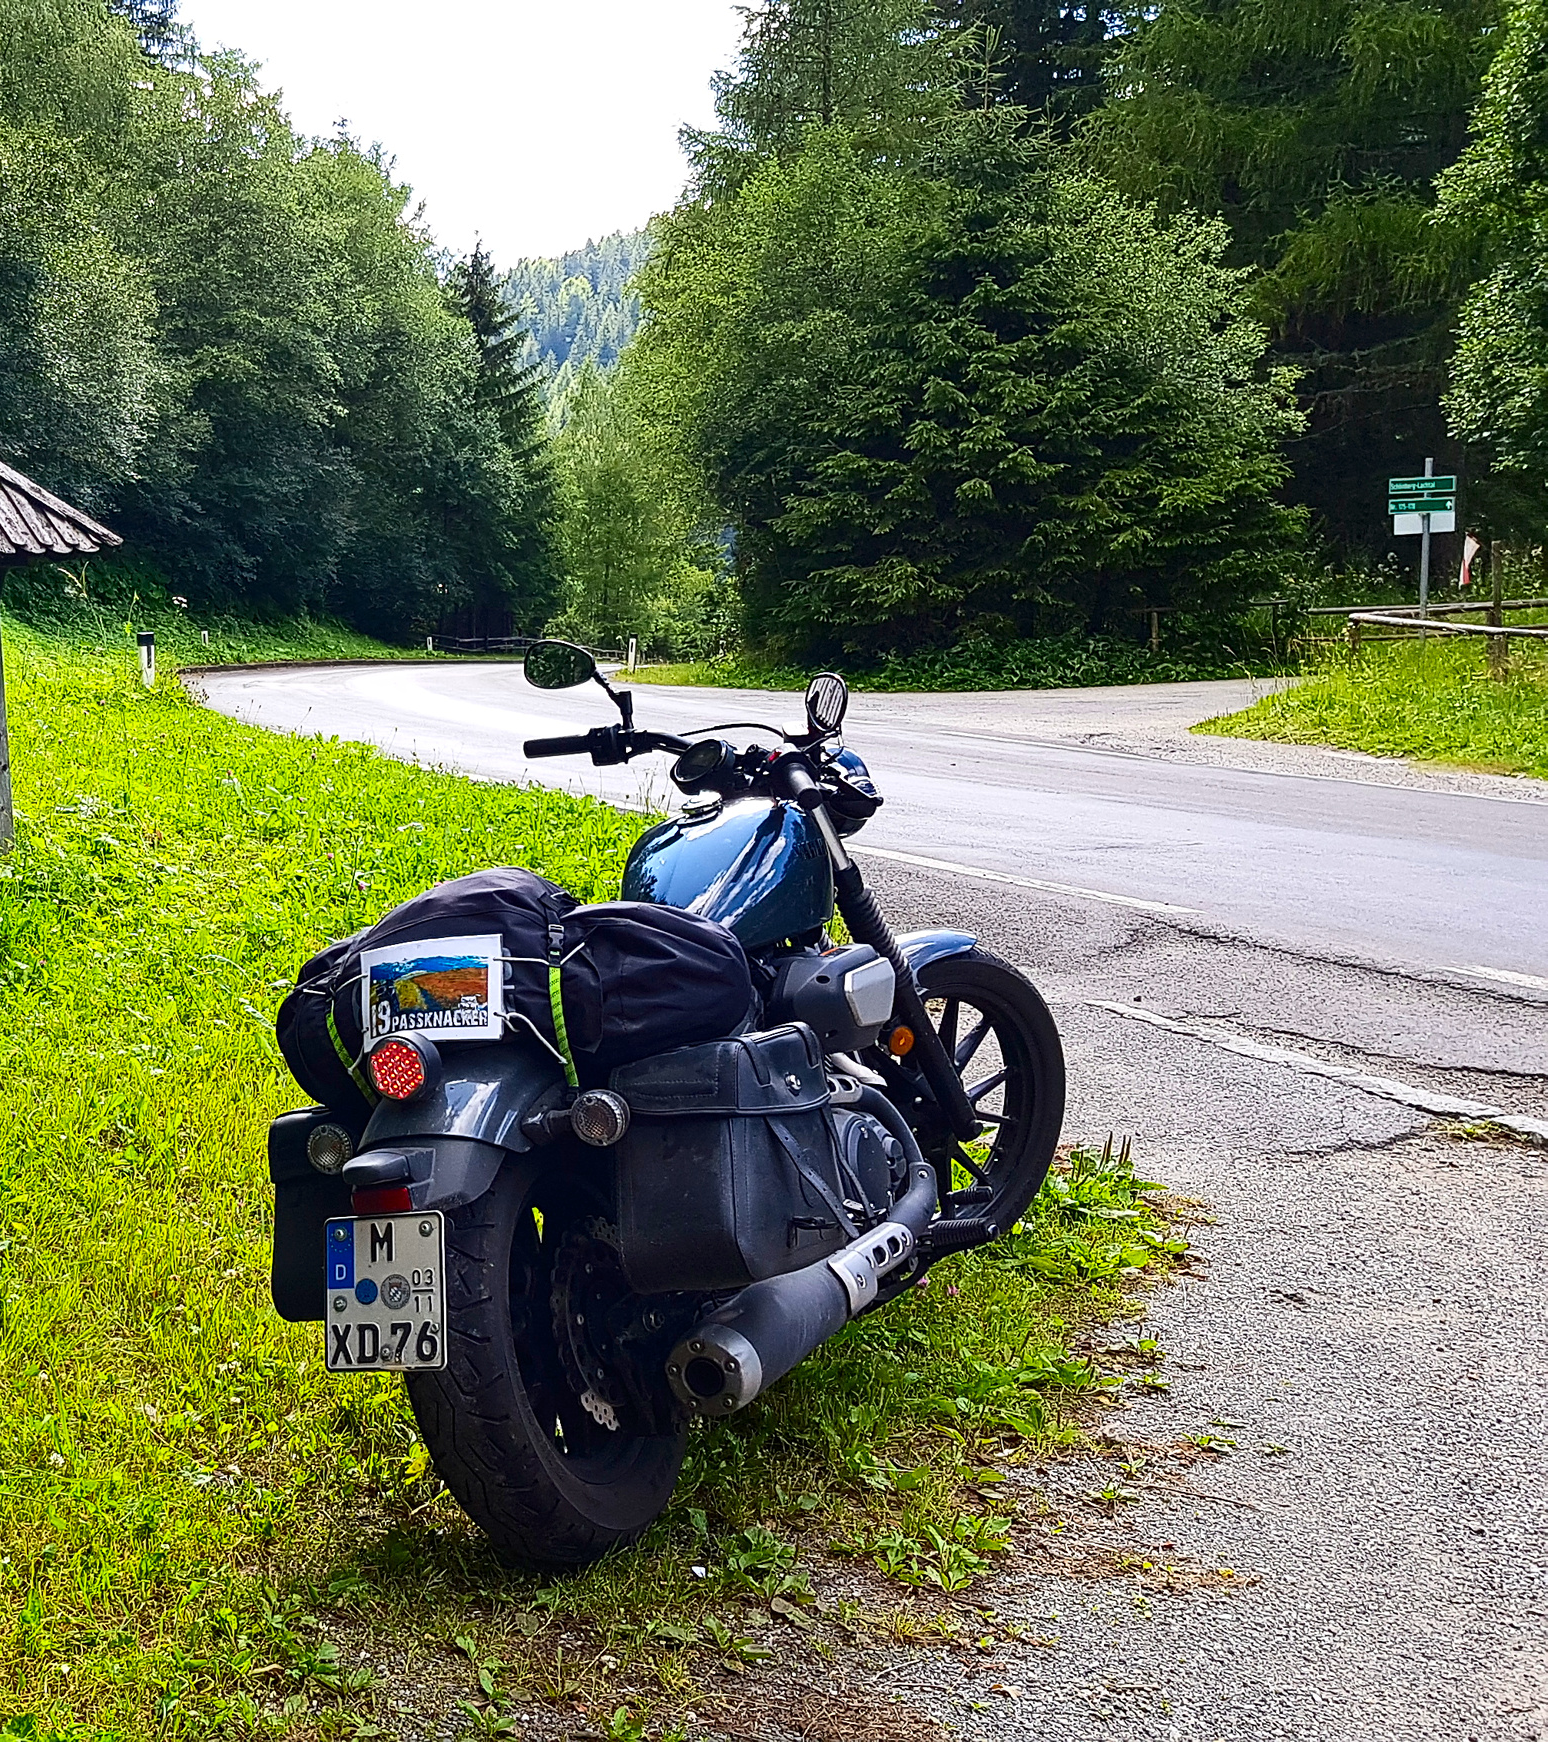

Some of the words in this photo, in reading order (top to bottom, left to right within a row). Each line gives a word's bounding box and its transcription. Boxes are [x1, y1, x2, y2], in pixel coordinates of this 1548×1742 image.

[371, 1000, 392, 1038] 19
[392, 1009, 489, 1031] PASSKNACKER
[370, 1221, 395, 1263] M
[335, 1264, 347, 1281] D
[412, 1268, 435, 1287] 03
[414, 1295, 434, 1313] 11
[331, 1322, 381, 1365] XD
[390, 1320, 439, 1364] 76
